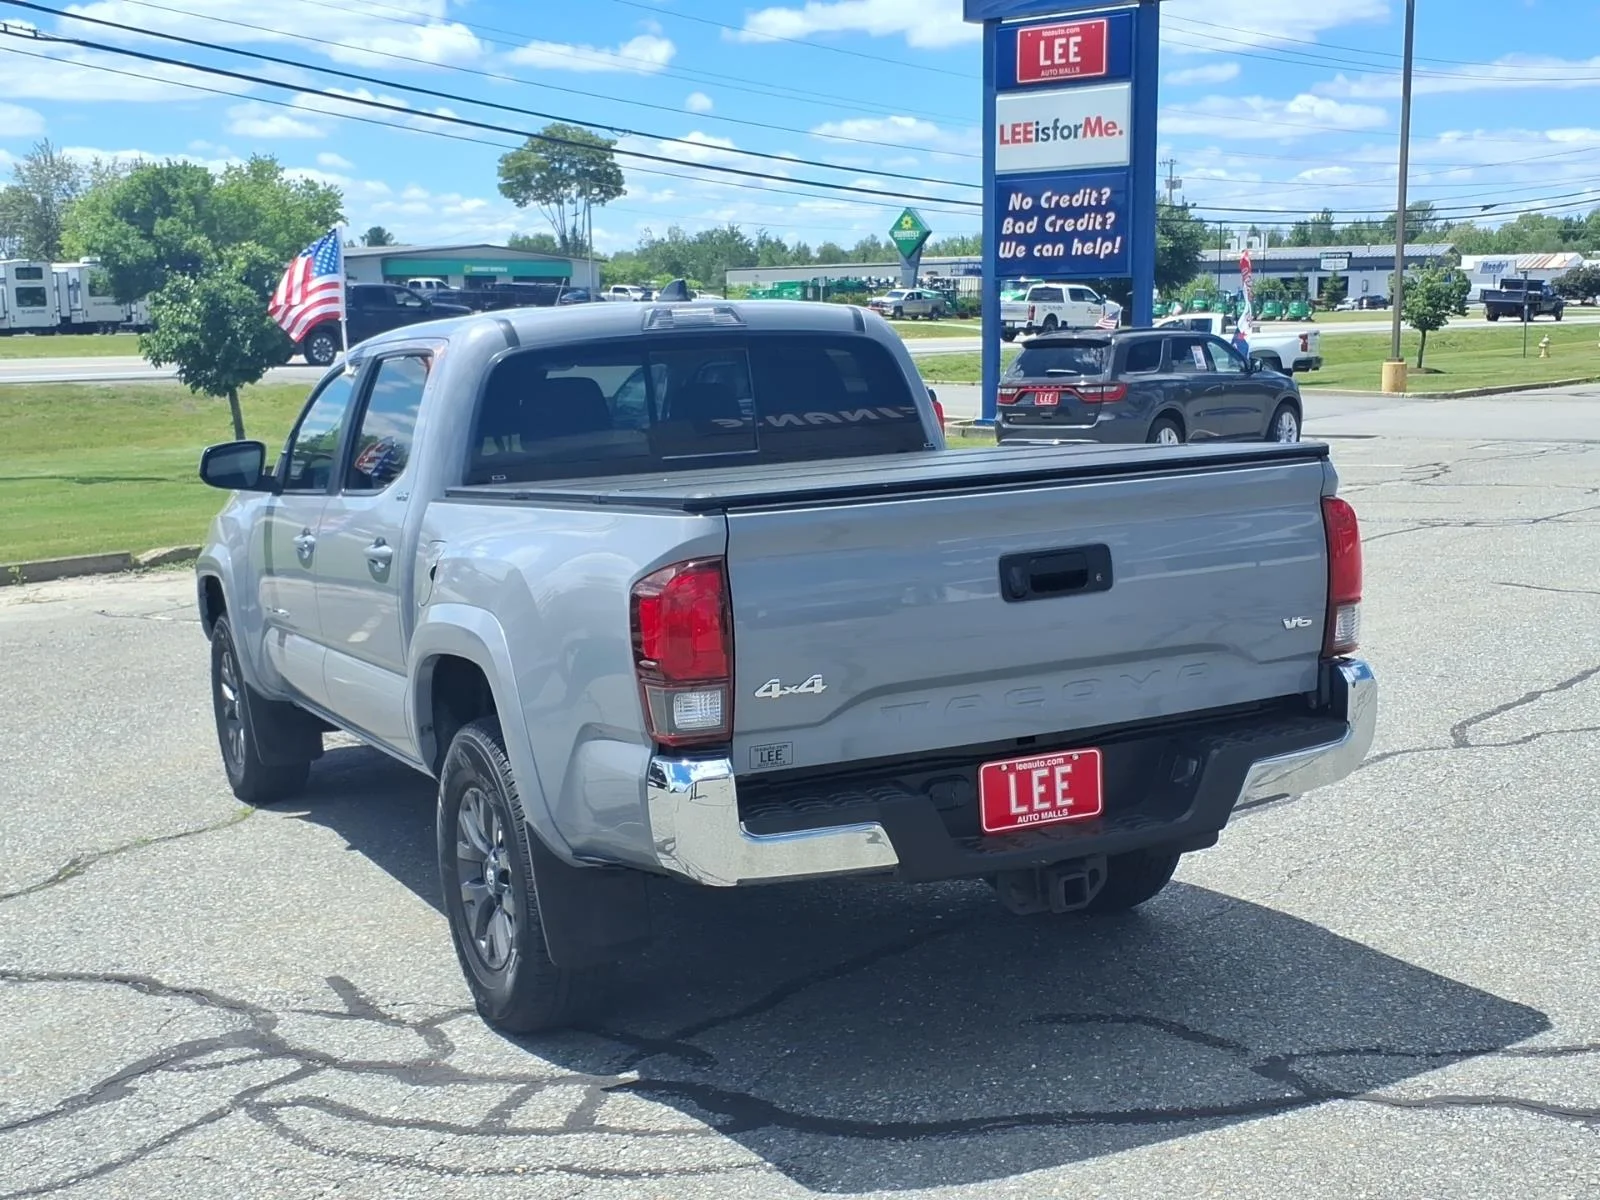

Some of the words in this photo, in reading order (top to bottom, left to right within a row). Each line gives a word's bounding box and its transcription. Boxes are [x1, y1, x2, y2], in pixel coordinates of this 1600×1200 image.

[1039, 36, 1082, 66] LEE
[1041, 69, 1058, 77] AUTO
[999, 116, 1123, 145] LEEisforMe.
[1008, 193, 1033, 211] No
[1040, 187, 1111, 209] Credit?
[1001, 216, 1038, 235] Bad
[1045, 211, 1116, 233] Credit?
[999, 241, 1026, 258] We
[1033, 243, 1064, 257] can
[1071, 236, 1121, 259] help!
[1282, 616, 1312, 630] V6
[754, 673, 828, 698] 4x4
[760, 749, 783, 763] LEE
[1015, 757, 1065, 771] leeauto.com
[1008, 764, 1074, 815] LEE
[1017, 814, 1040, 824] AUTO
[1041, 808, 1069, 820] MALLS
